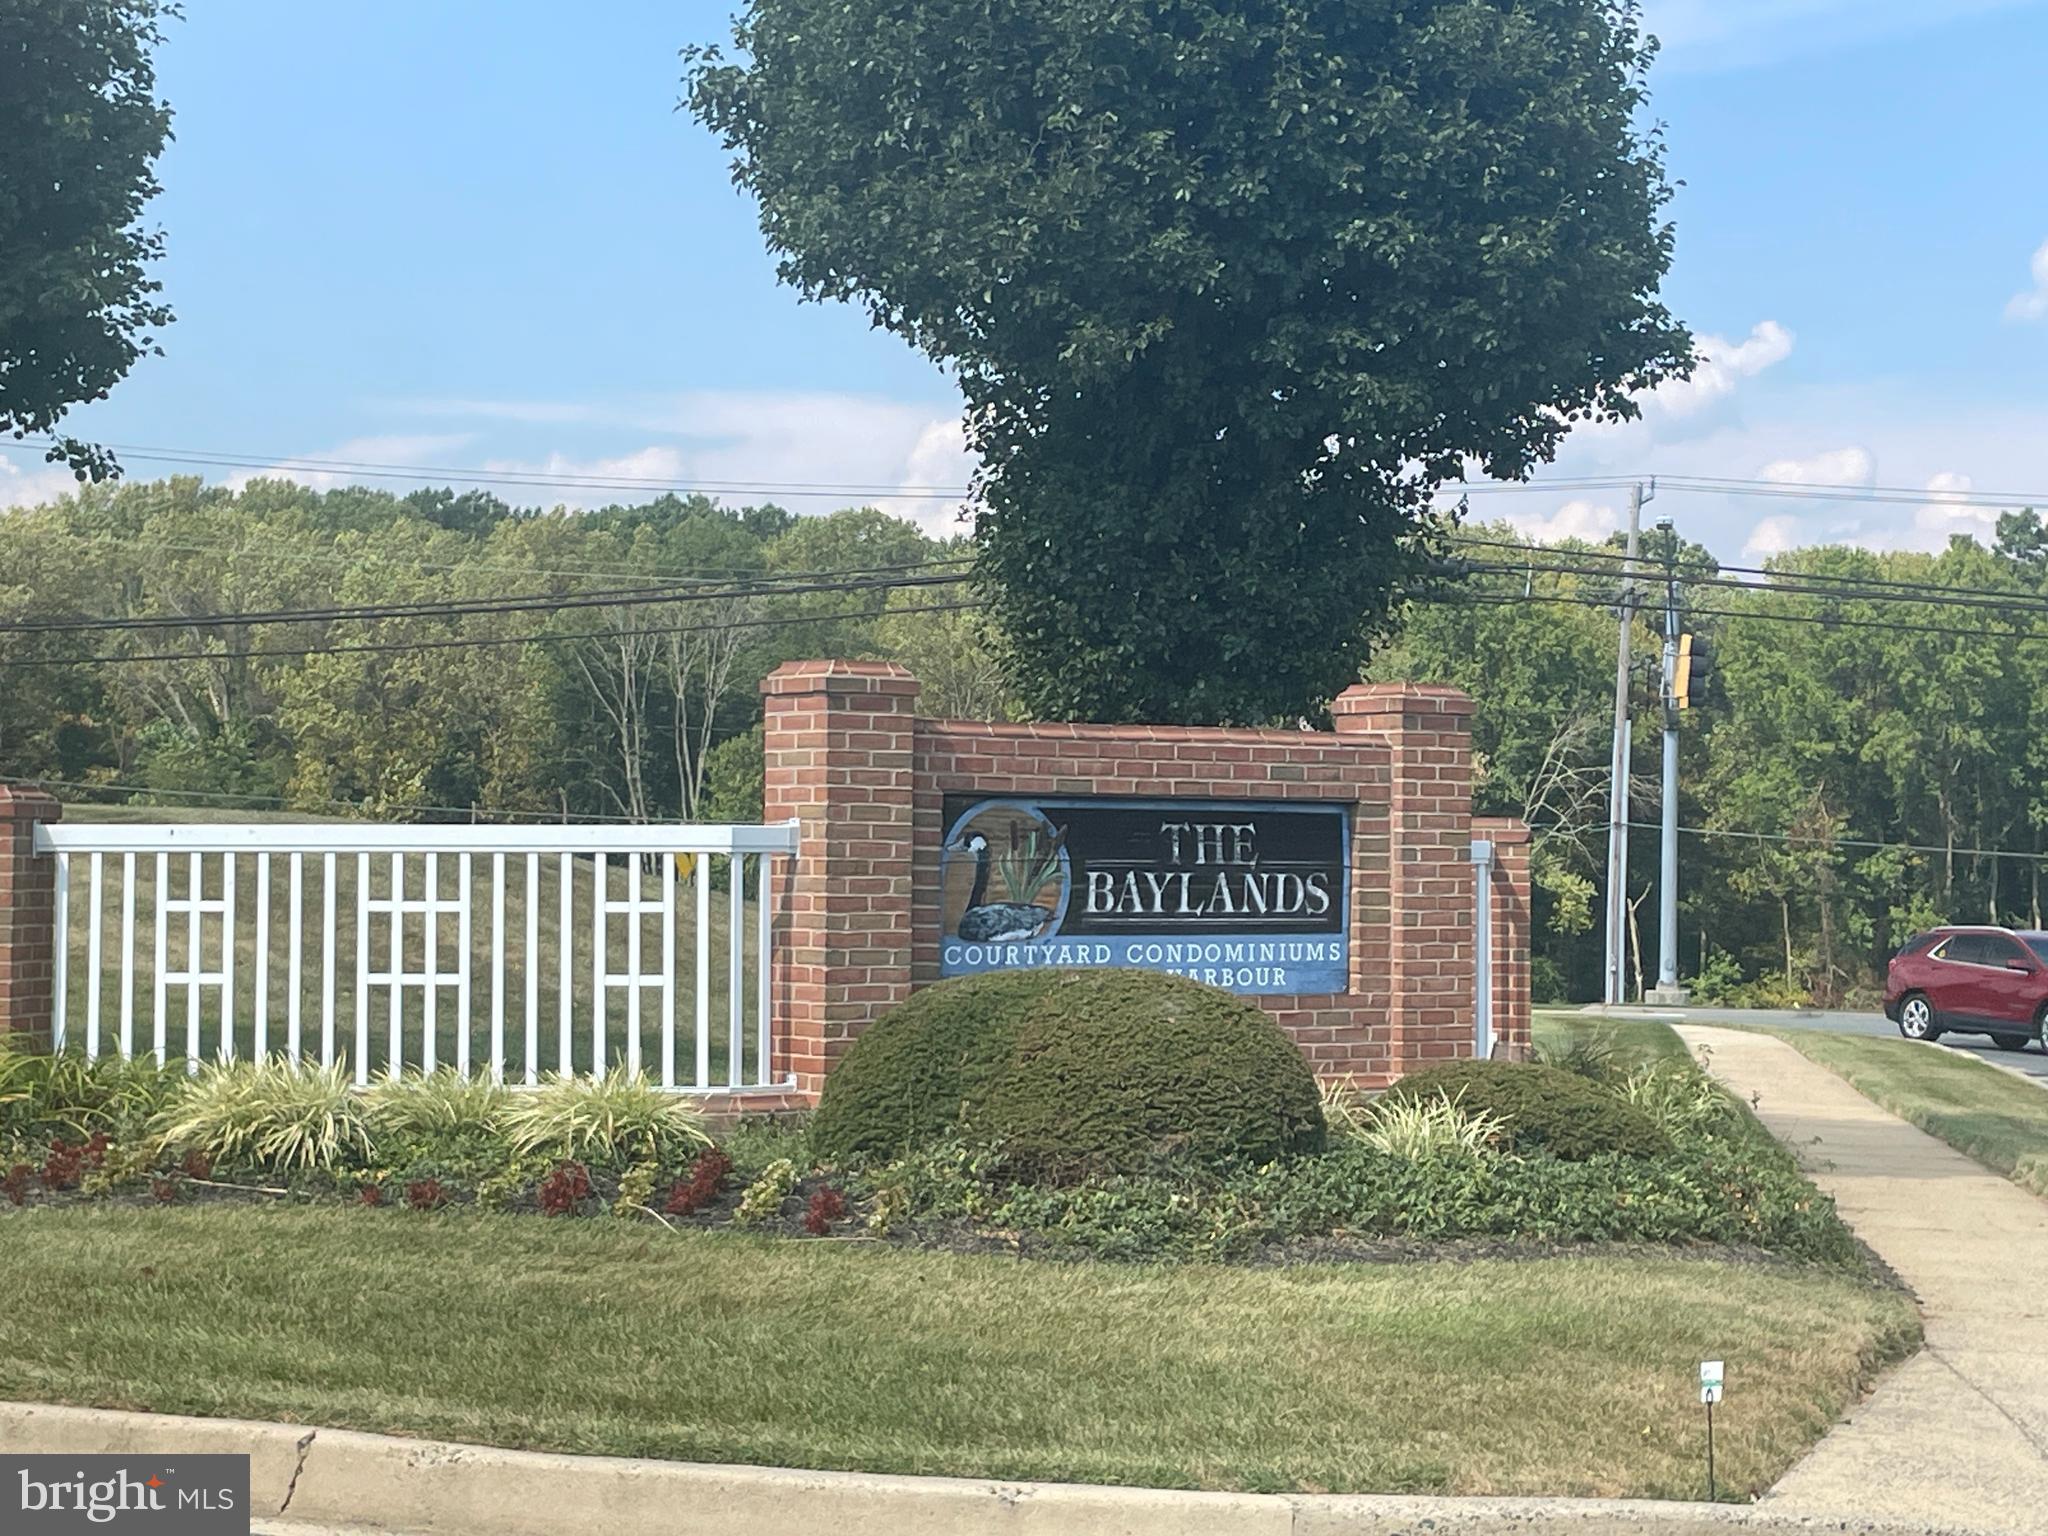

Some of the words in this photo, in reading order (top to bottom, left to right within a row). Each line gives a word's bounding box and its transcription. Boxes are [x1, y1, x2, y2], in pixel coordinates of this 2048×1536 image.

[1160, 822, 1260, 868] THE
[1085, 871, 1332, 915] BAYLANDS
[944, 944, 1111, 966] COURTYARD
[1126, 943, 1342, 962] CONDOMINIUMS
[1166, 967, 1286, 986] ARBOUR
